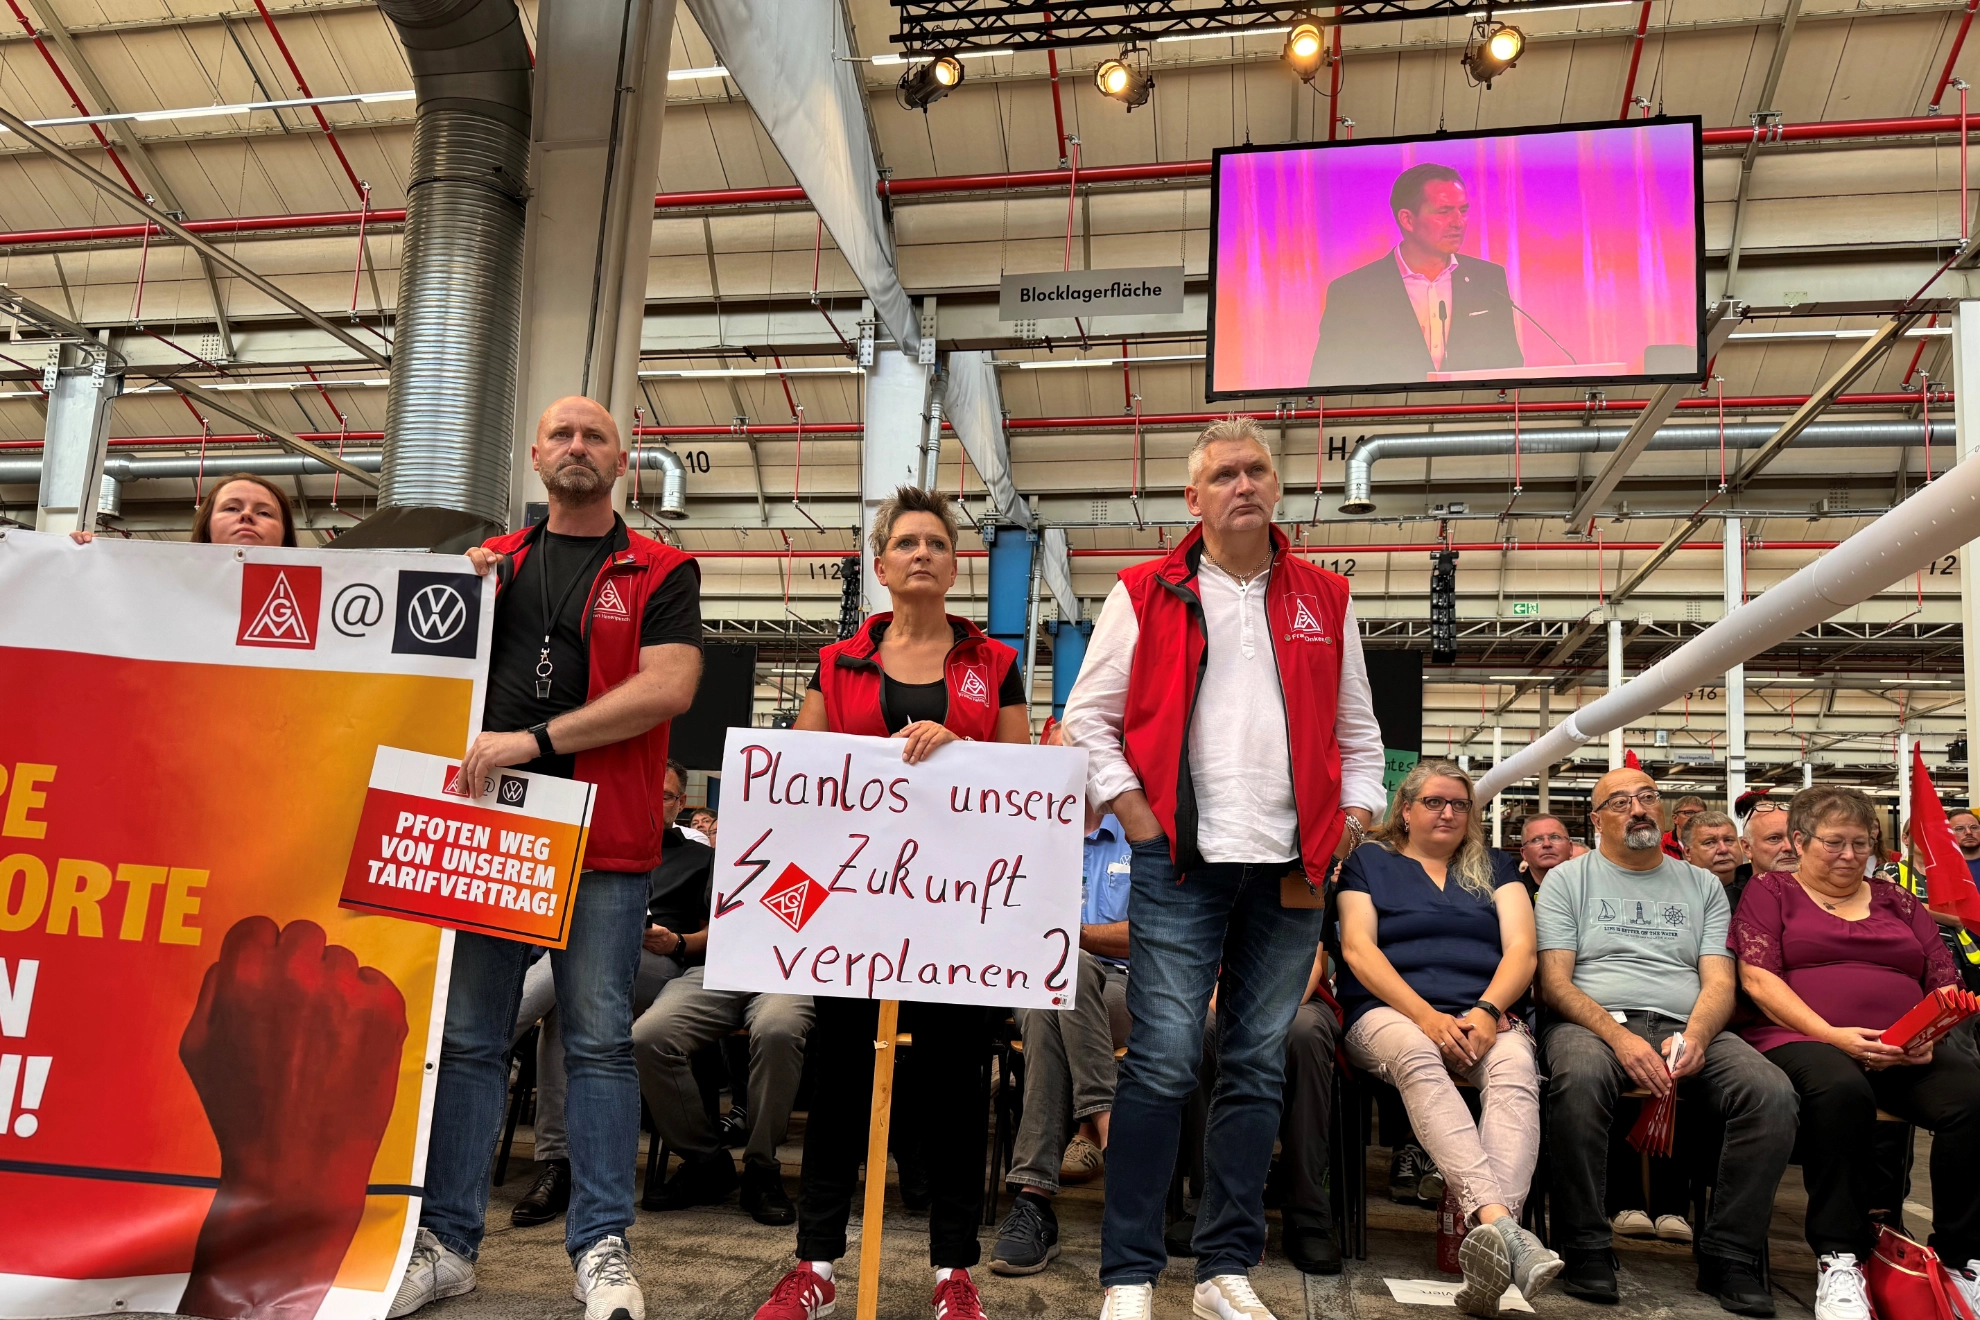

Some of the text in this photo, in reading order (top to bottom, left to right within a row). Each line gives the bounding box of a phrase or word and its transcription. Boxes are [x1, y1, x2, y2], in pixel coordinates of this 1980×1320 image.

[1020, 281, 1163, 303] Blocklagerfläche
[674, 451, 711, 474] 10
[331, 583, 384, 638] @
[410, 586, 464, 640] VW
[740, 744, 1078, 825] Planlos unsere
[381, 835, 556, 889] VON UNSEREM
[395, 811, 551, 861] PFOTEN WEG
[368, 859, 558, 917] TARIFVERTRAG!
[827, 833, 1027, 925] Zukunft
